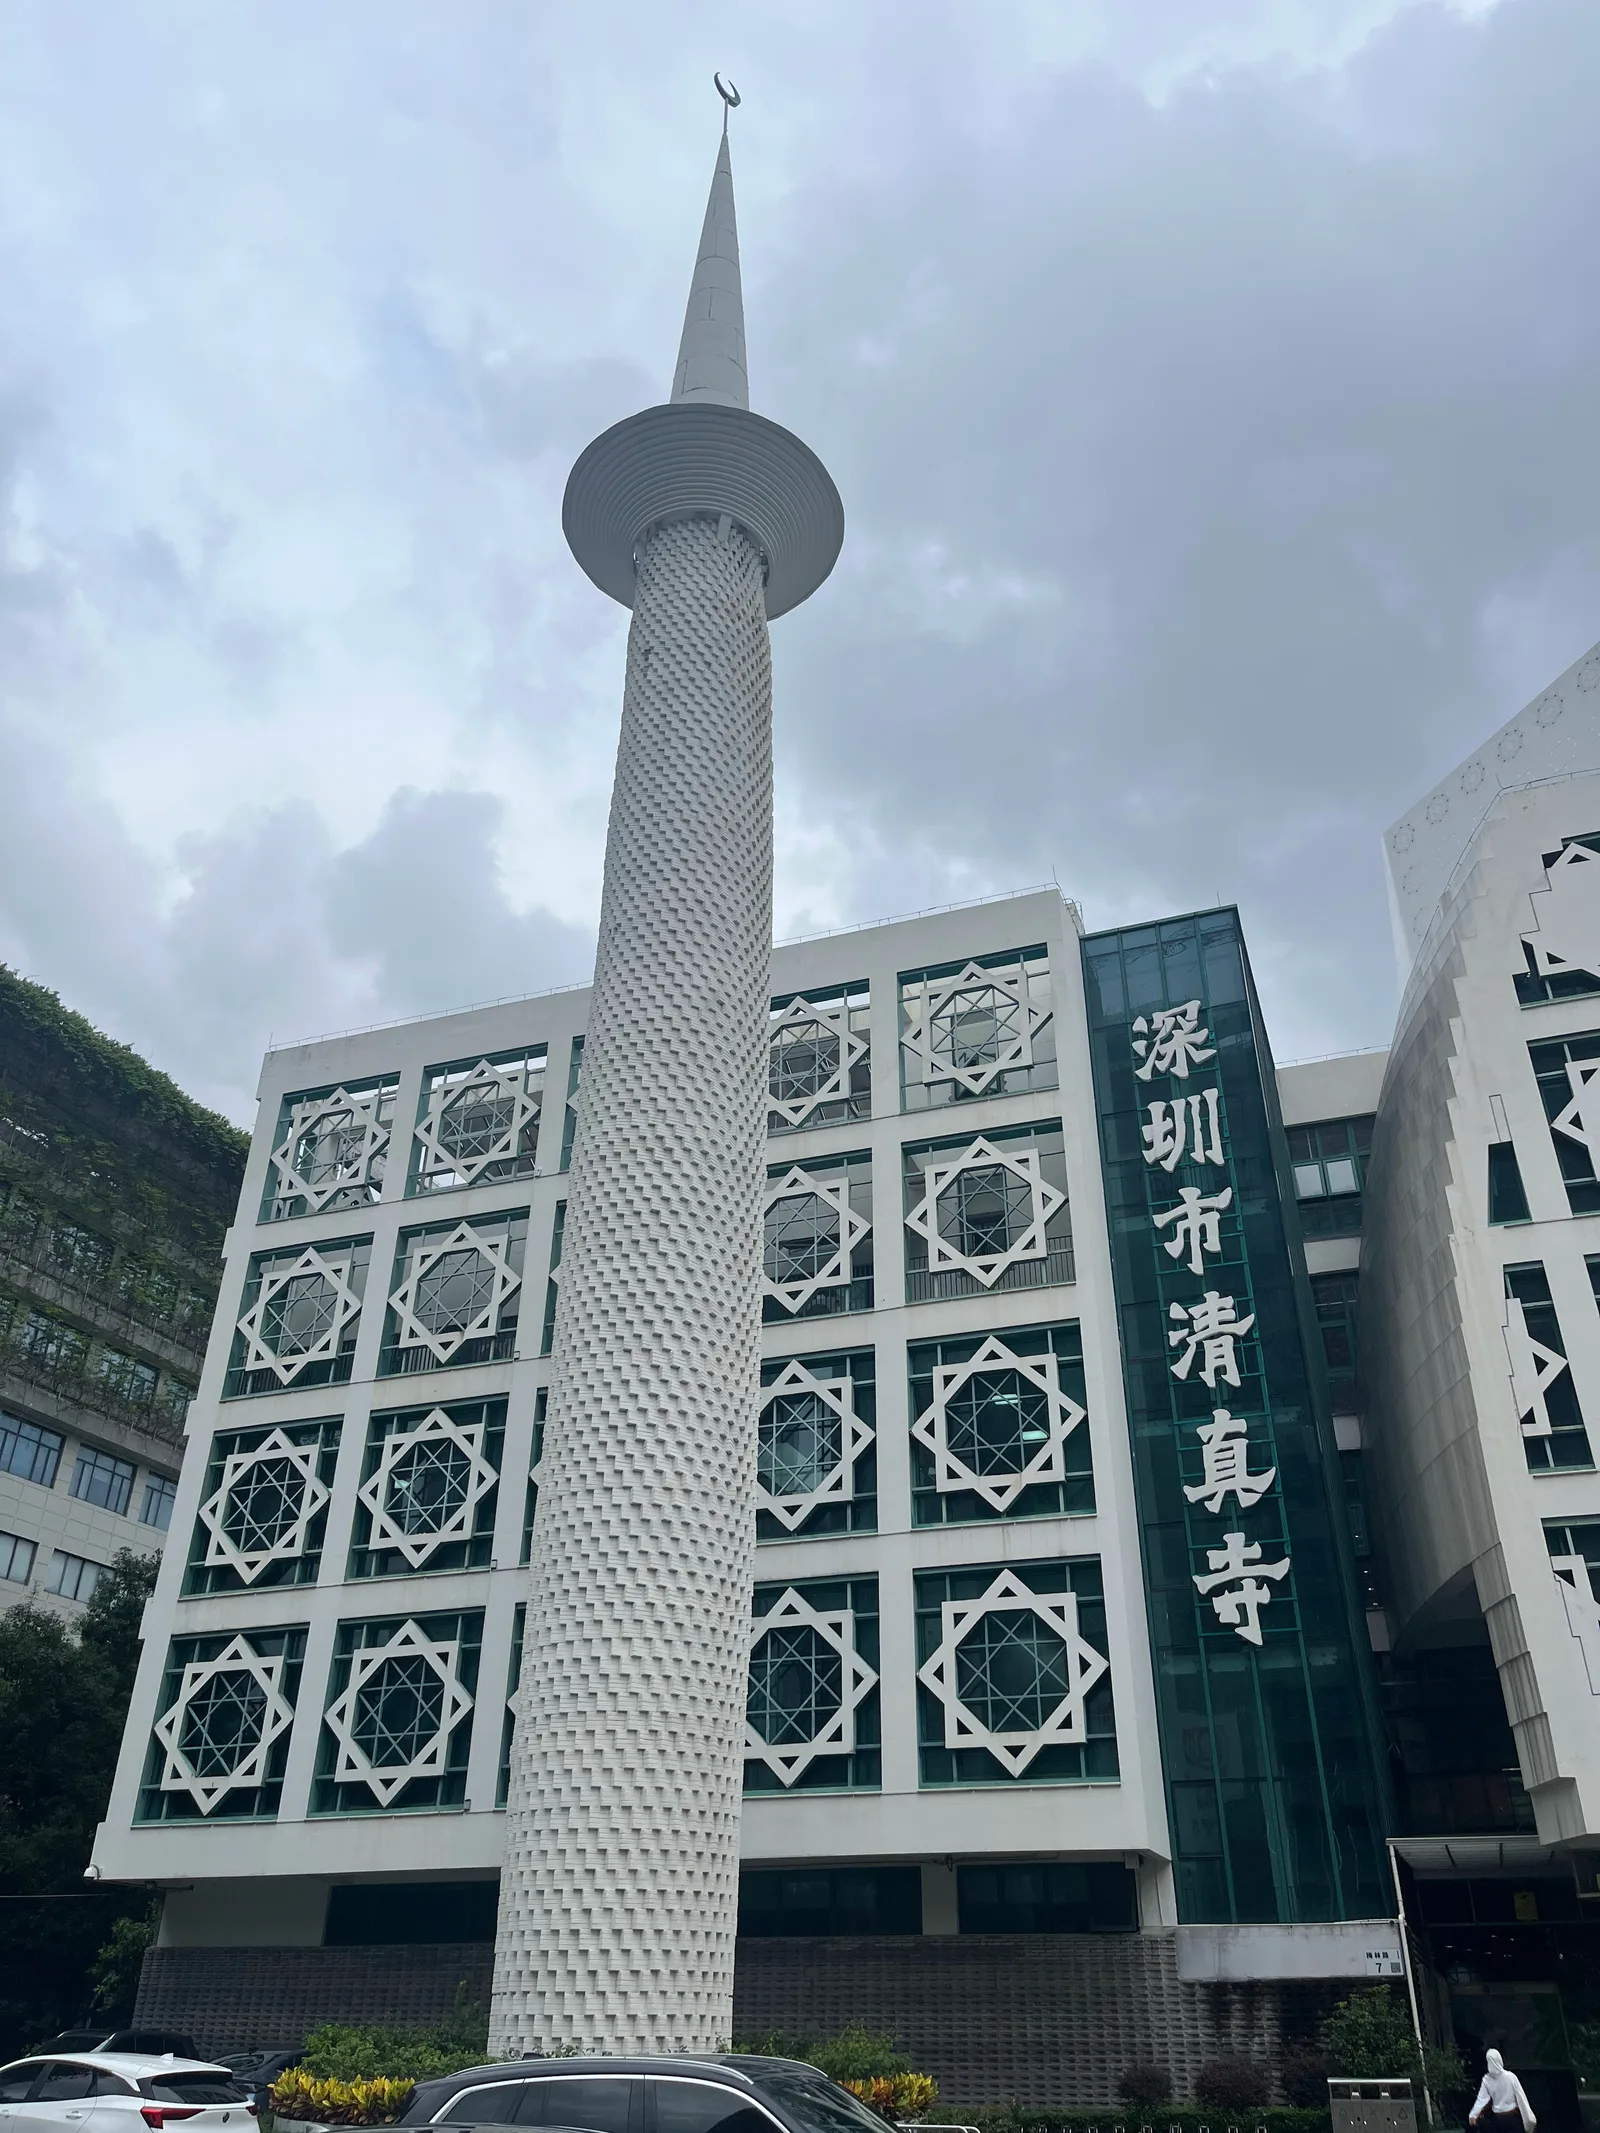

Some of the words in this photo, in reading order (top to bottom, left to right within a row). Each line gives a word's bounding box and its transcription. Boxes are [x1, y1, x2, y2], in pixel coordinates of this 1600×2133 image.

[1131, 999, 1290, 1647] 深圳市清真寺
[1375, 1962, 1382, 1974] 7
